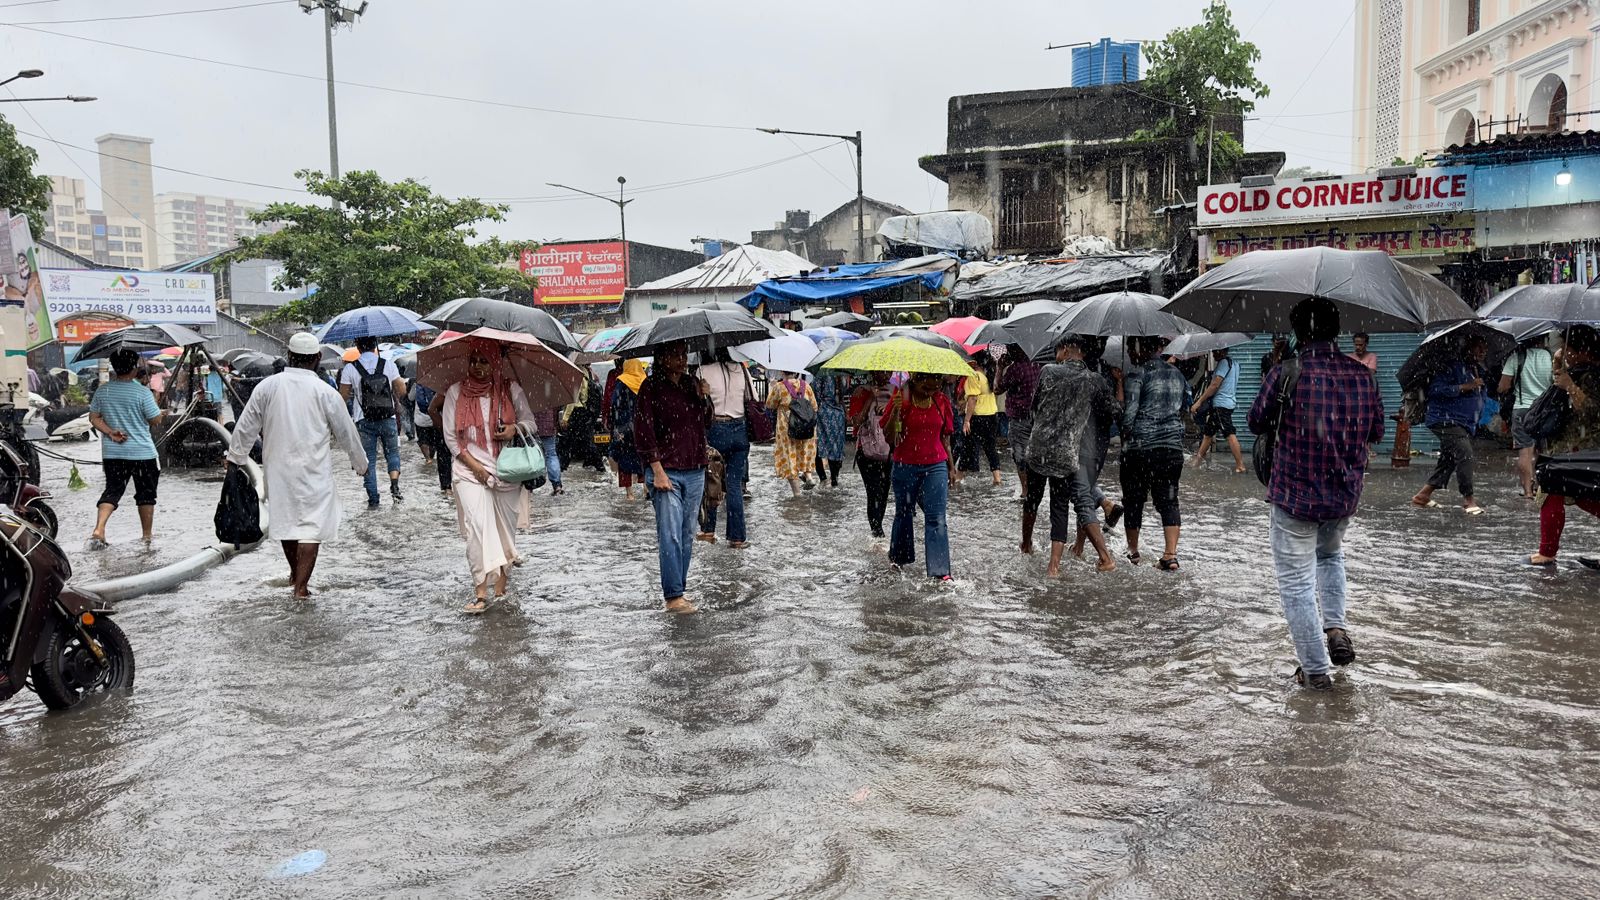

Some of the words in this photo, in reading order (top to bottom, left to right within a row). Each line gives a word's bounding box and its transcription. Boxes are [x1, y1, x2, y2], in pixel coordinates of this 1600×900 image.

[1203, 189, 1270, 215] COLD
[1276, 180, 1384, 209] CORNER
[1388, 174, 1468, 202] JUICE
[525, 249, 583, 265] शालीमार
[539, 275, 587, 287] SHALIMAR
[589, 278, 624, 286] RESTAURANT
[49, 302, 81, 313] 9203
[86, 303, 124, 313] 74688
[137, 304, 173, 314] 98333
[176, 304, 211, 315] 44444
